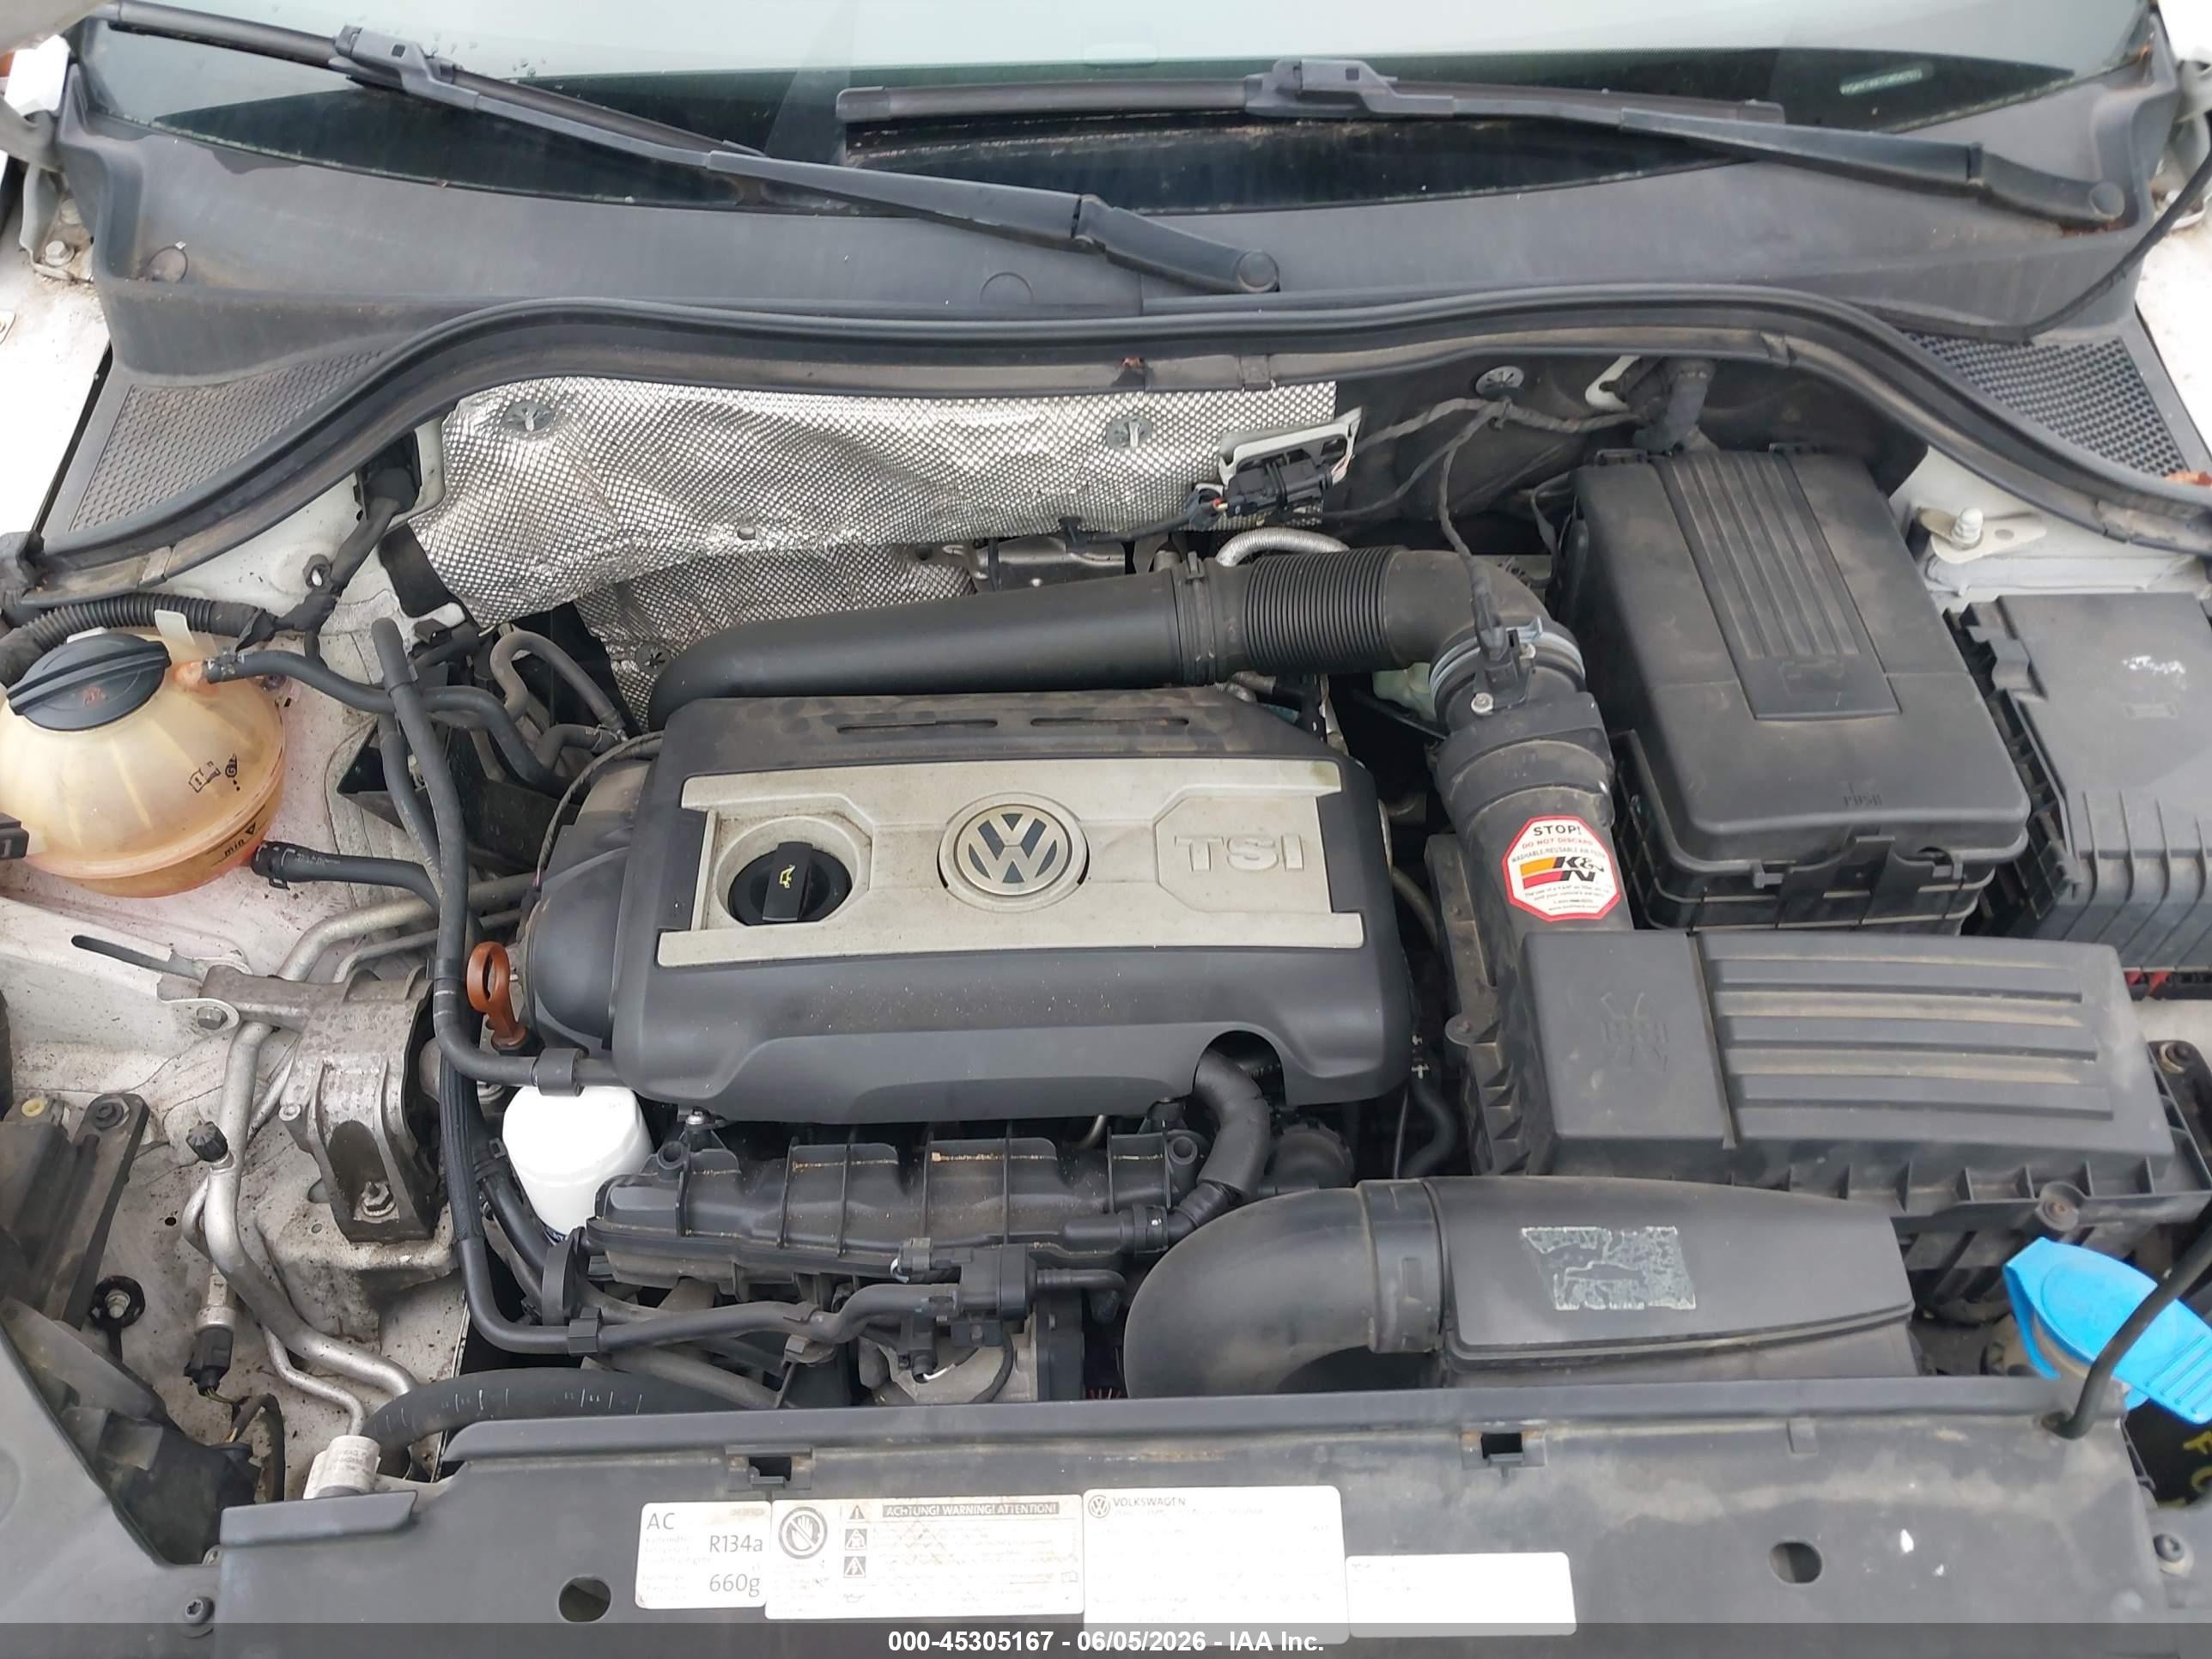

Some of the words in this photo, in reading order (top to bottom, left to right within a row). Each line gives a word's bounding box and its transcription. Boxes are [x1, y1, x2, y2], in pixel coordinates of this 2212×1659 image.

[1534, 824, 1582, 836] STOP!
[224, 839, 246, 858] min
[1537, 837, 1555, 846] NOT
[1558, 837, 1594, 846] DISCARD
[1174, 835, 1305, 872] TSI
[885, 1504, 940, 1516] ACHTUNG!
[943, 1504, 995, 1516] WARNING!
[997, 1502, 1057, 1515] ATTENTION!
[1113, 1497, 1187, 1507] VOLKSWAGEN
[646, 1512, 676, 1530] AC
[709, 1534, 763, 1553] R134a
[709, 1573, 761, 1598] 660g
